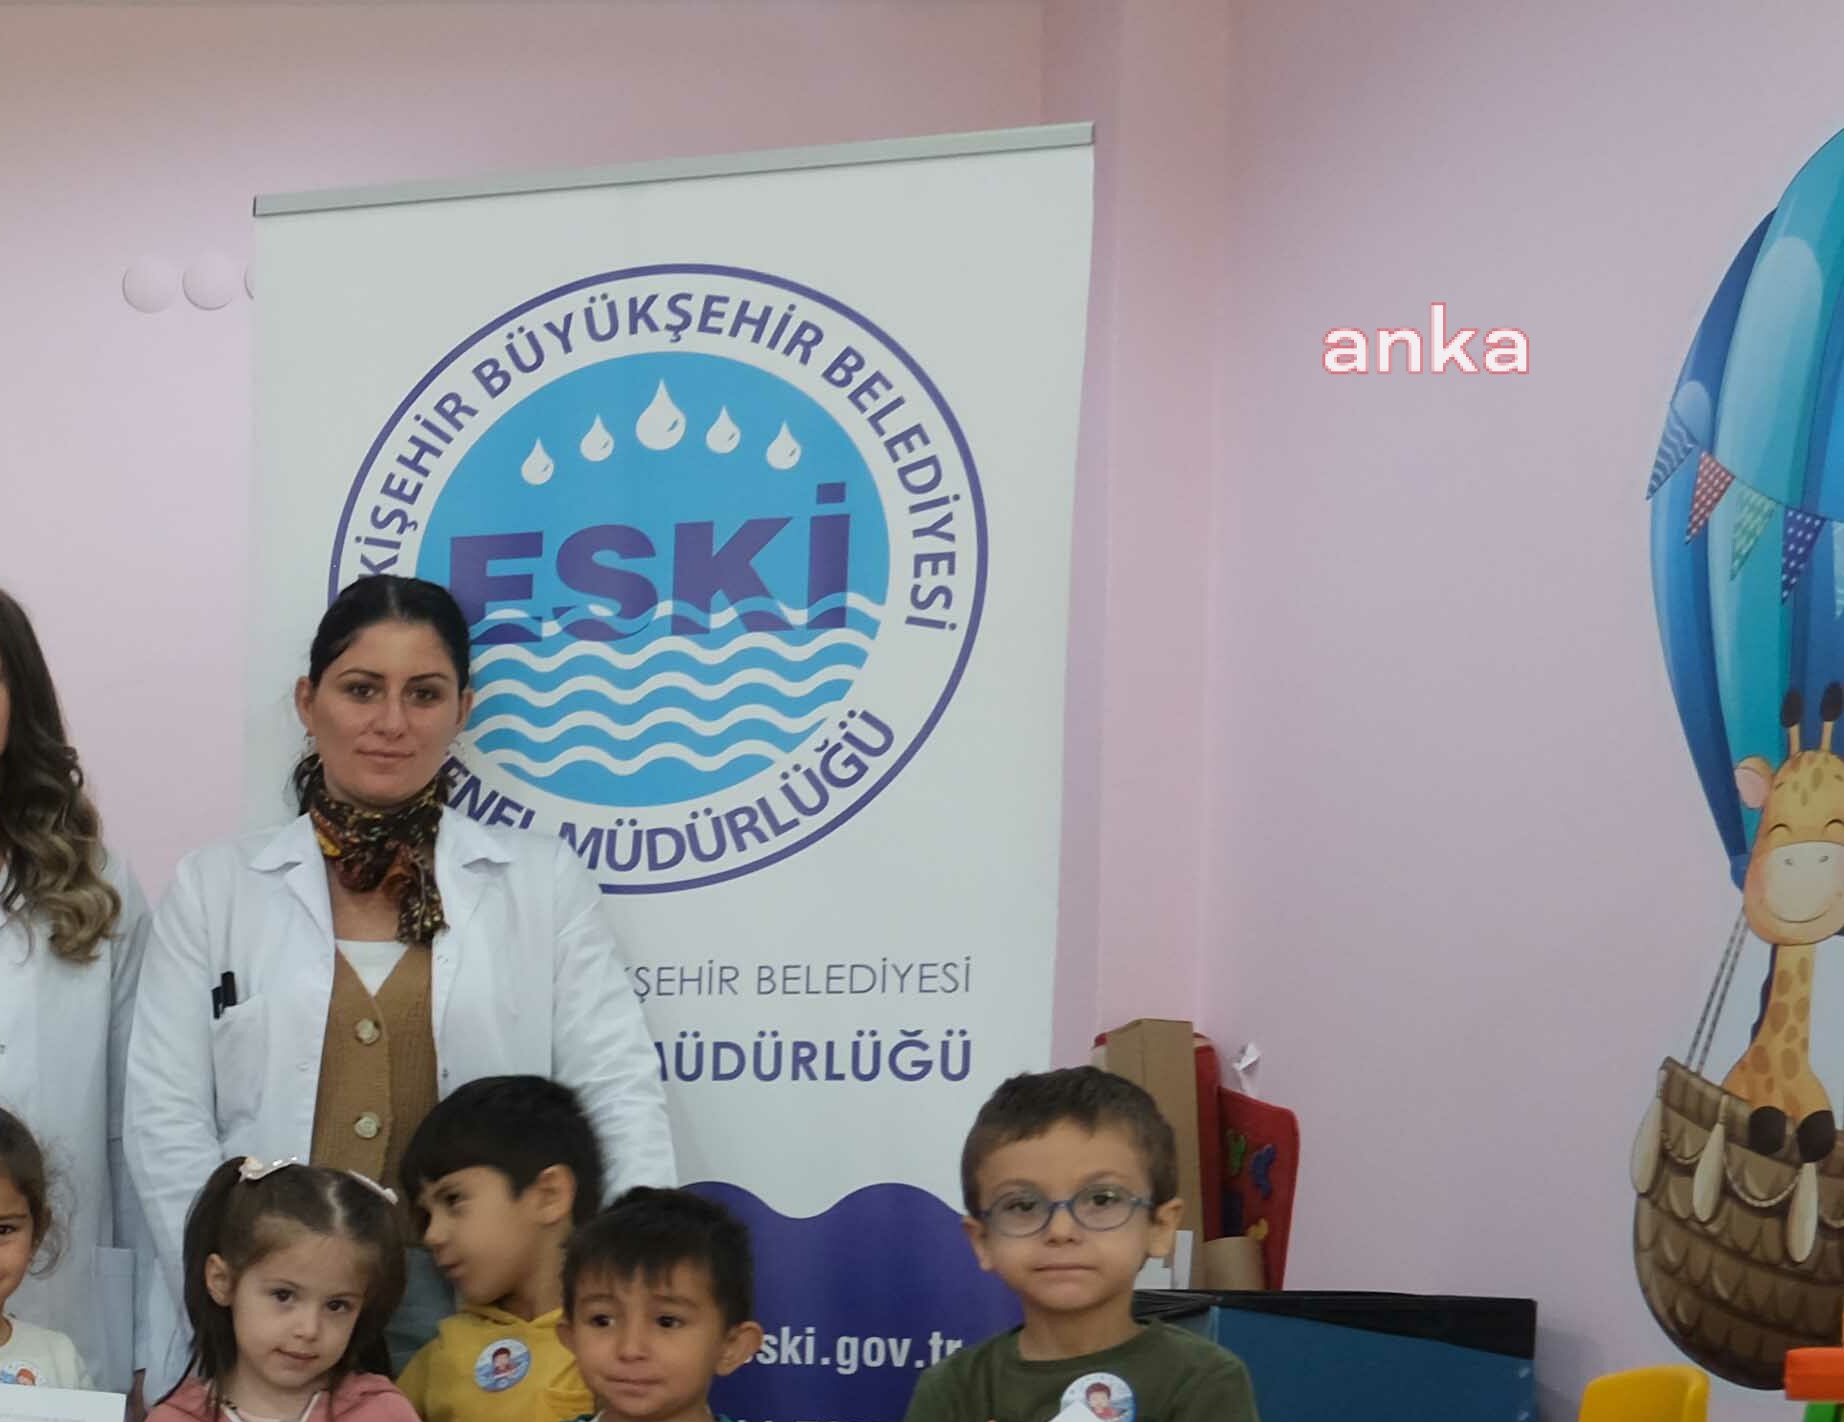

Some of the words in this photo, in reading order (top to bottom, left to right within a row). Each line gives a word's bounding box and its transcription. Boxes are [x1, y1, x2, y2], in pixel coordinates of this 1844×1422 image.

[355, 392, 477, 584] KİŞEHİR
[473, 291, 825, 402] BÜYÜKŞEHİR
[821, 347, 961, 634] BELEDİYESİ
[449, 482, 851, 646] ESKİ
[560, 709, 896, 873] MÜDÜRLÜĞÜ
[625, 959, 740, 1005] ŞEHİR
[756, 955, 972, 997] BELEDİYESİ
[743, 1325, 963, 1375] ski.gov.tr
